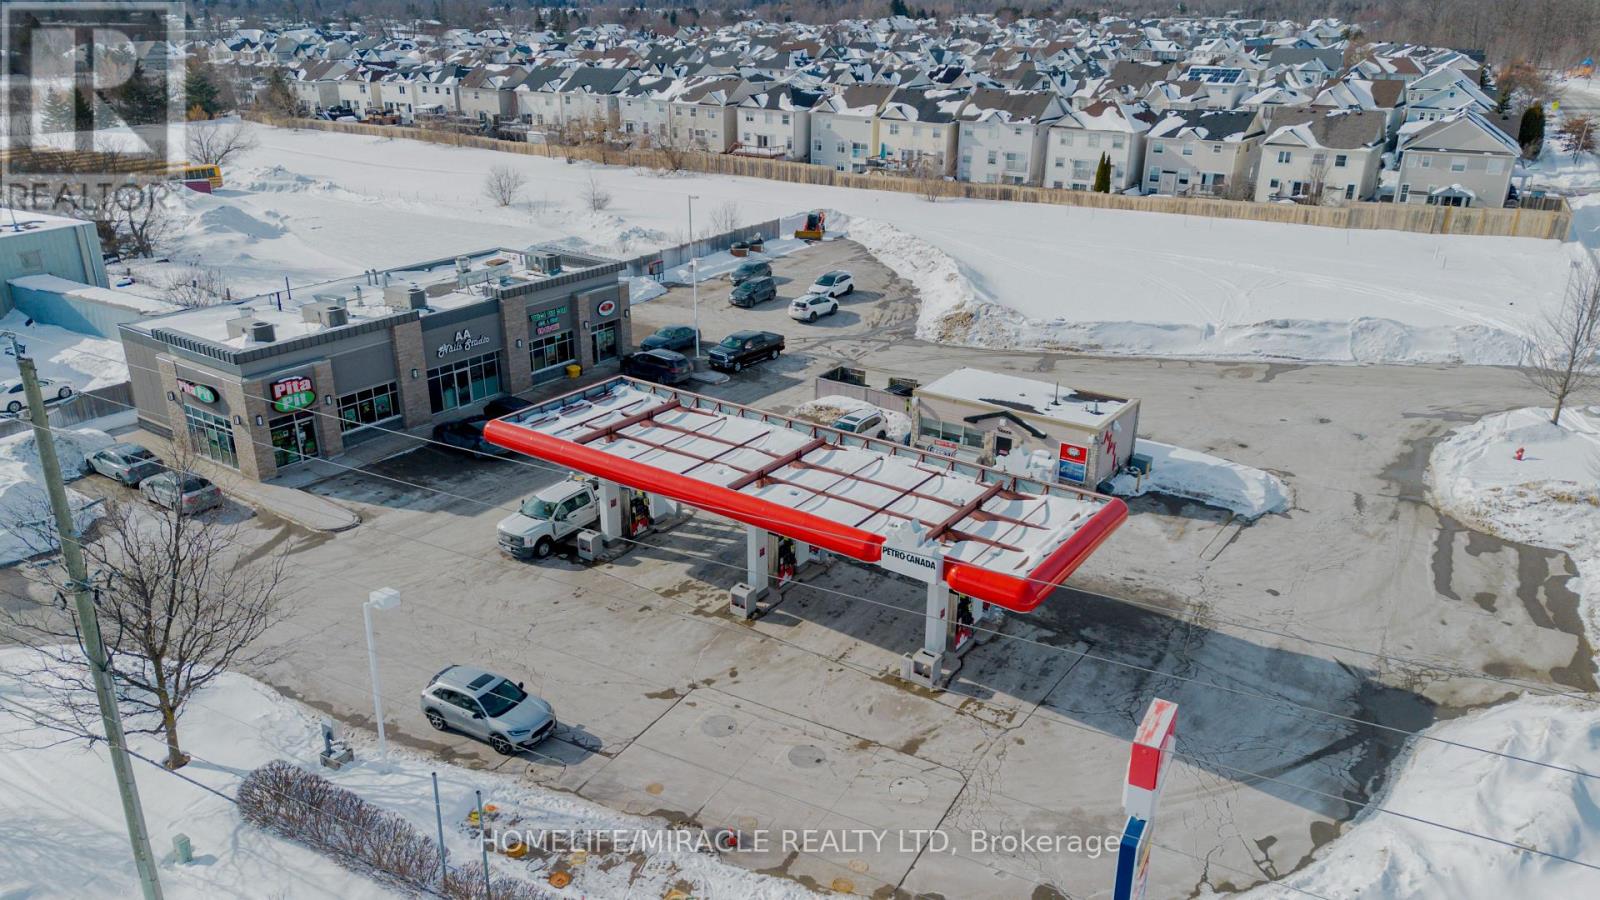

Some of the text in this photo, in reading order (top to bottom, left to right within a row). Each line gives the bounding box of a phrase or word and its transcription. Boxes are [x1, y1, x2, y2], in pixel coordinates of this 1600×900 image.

[455, 329, 471, 341] AA
[274, 379, 311, 398] Pita
[282, 392, 307, 410] Pit
